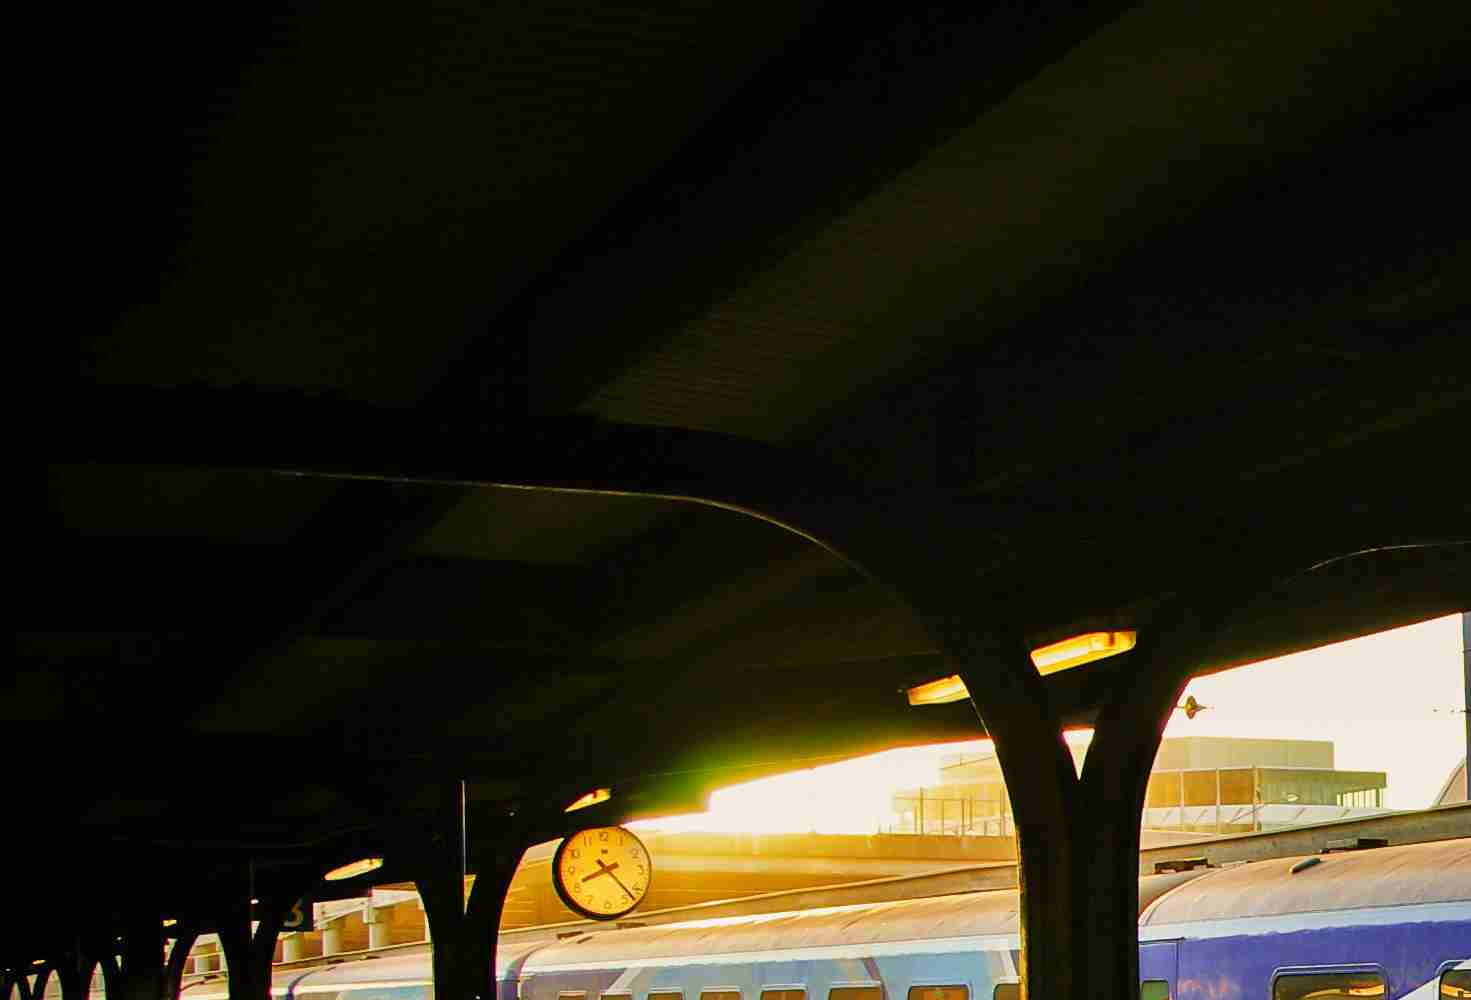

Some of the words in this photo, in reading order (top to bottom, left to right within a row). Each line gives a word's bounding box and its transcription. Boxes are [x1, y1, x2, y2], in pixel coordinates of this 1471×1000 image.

[599, 831, 609, 842] 12
[631, 848, 640, 859] 2
[636, 864, 645, 876] 3
[603, 900, 612, 910] 6
